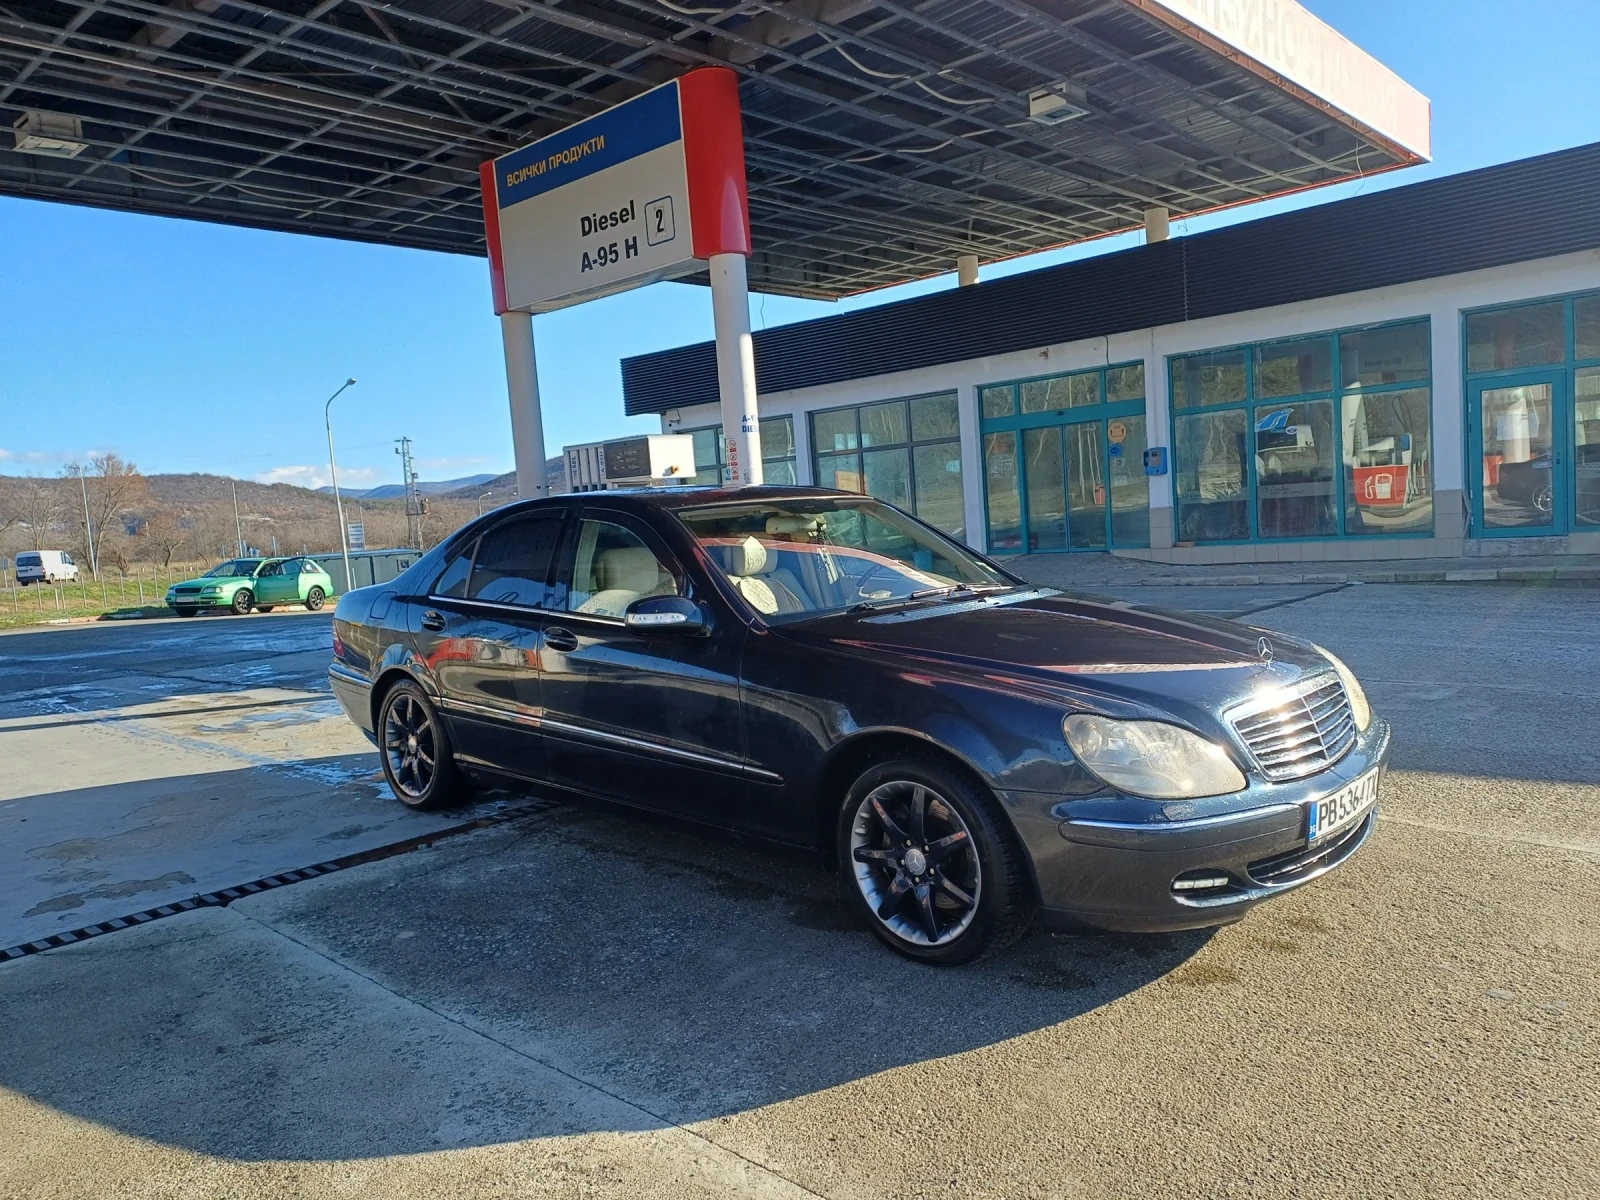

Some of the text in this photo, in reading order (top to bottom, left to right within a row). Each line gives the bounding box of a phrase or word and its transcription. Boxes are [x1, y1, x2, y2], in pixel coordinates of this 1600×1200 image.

[507, 135, 605, 187] ВСИЧКИ ПРОДУКТИ
[580, 199, 636, 237] Diesel
[655, 208, 665, 233] 2
[581, 242, 619, 273] A-95
